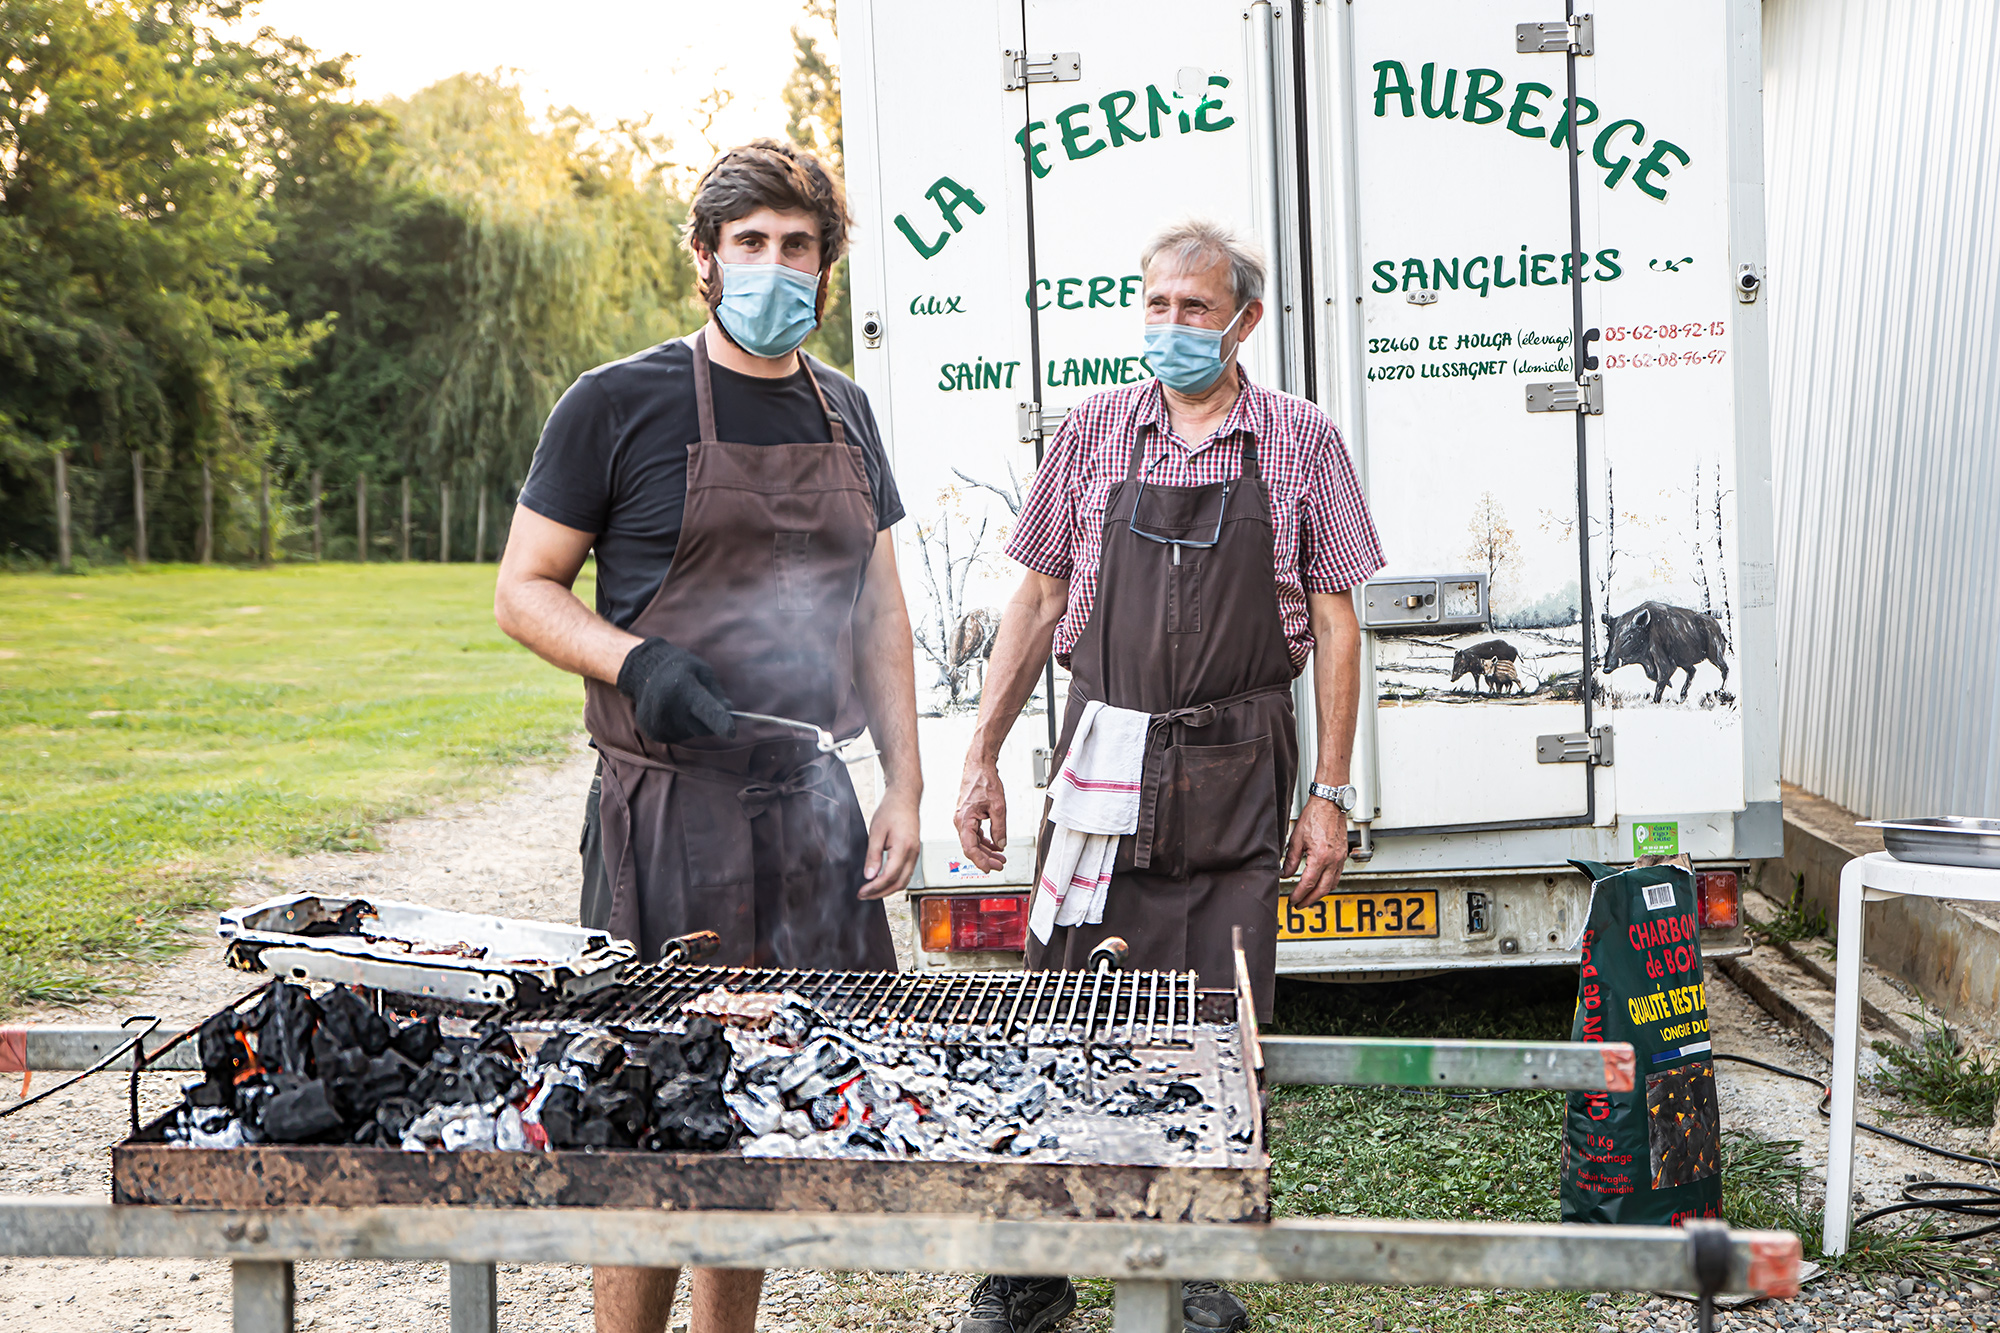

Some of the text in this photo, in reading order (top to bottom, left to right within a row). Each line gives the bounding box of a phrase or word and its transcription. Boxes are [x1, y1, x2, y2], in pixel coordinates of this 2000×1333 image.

[893, 176, 987, 260] LA
[1372, 59, 1692, 202] AUBERGE
[910, 294, 967, 316] aux
[1025, 275, 1143, 311] CERF
[1368, 327, 1573, 354] 32460 LE HOUGA (élevage)
[1605, 321, 1725, 342] 05-62-08-92-15
[1367, 355, 1574, 382] 40270 LUSSAGNET (domicile)
[1605, 349, 1727, 369] 05-62-08-96-97
[1628, 913, 1696, 951] CHARBON
[1646, 950, 1665, 980] de
[1660, 1022, 1691, 1041] LONGUE
[1586, 1133, 1595, 1147] 10
